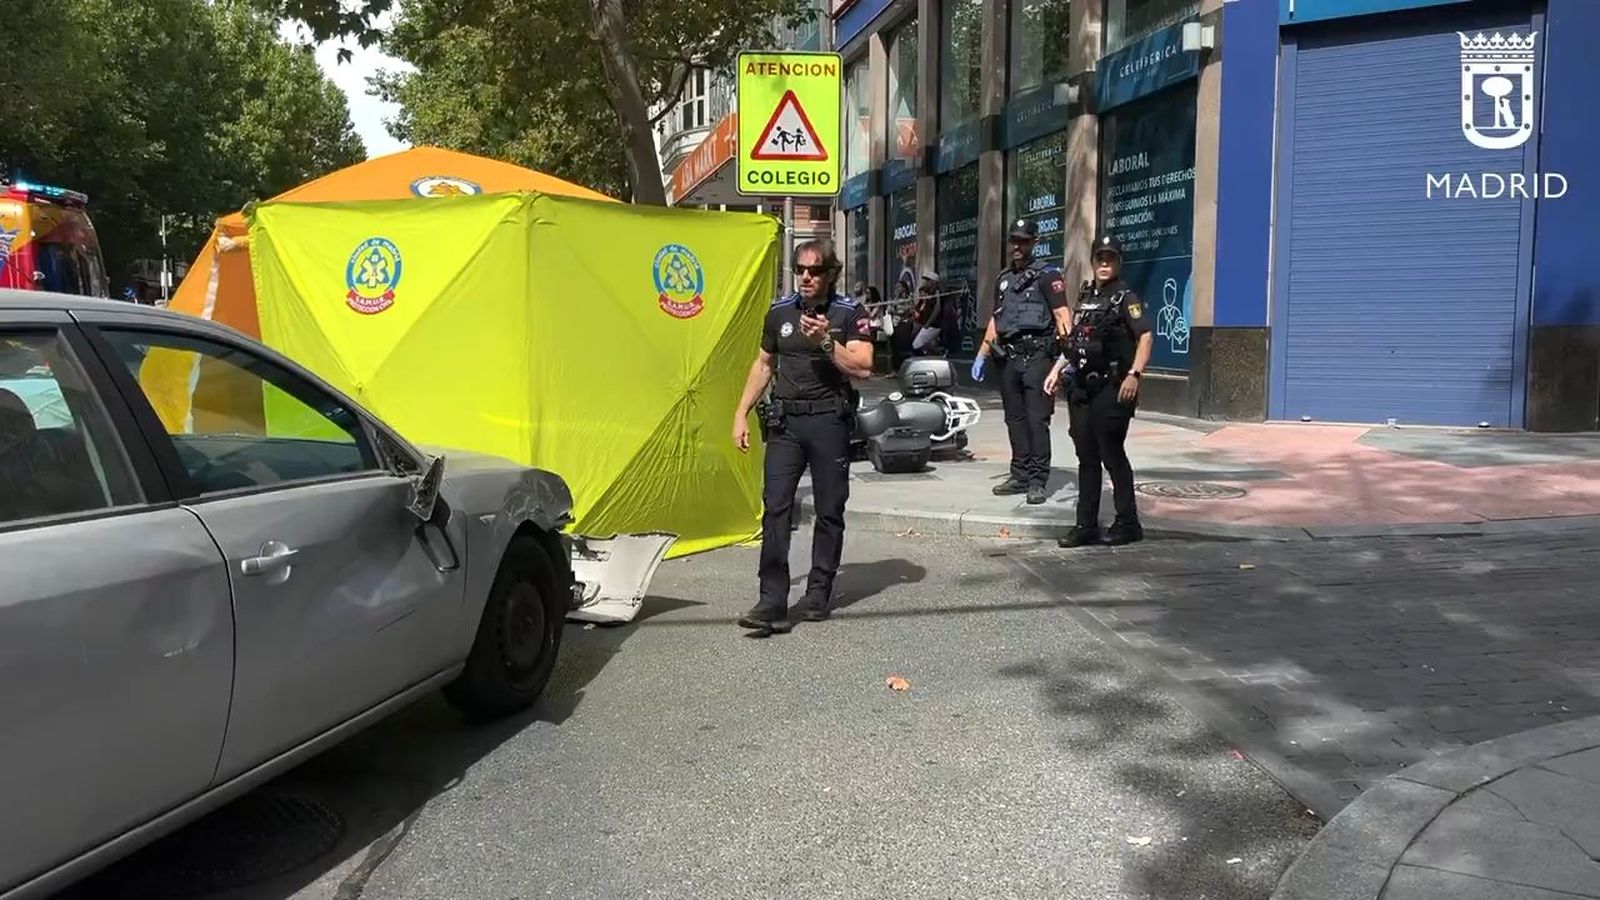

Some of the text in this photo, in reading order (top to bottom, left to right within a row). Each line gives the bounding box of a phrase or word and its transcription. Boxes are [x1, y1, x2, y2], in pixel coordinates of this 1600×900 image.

[746, 62, 836, 77] ATENCION
[1107, 152, 1150, 176] LABORAL
[747, 170, 831, 185] COLEGIO
[1149, 176, 1161, 188] TUS
[1161, 166, 1200, 185] DERECHOS
